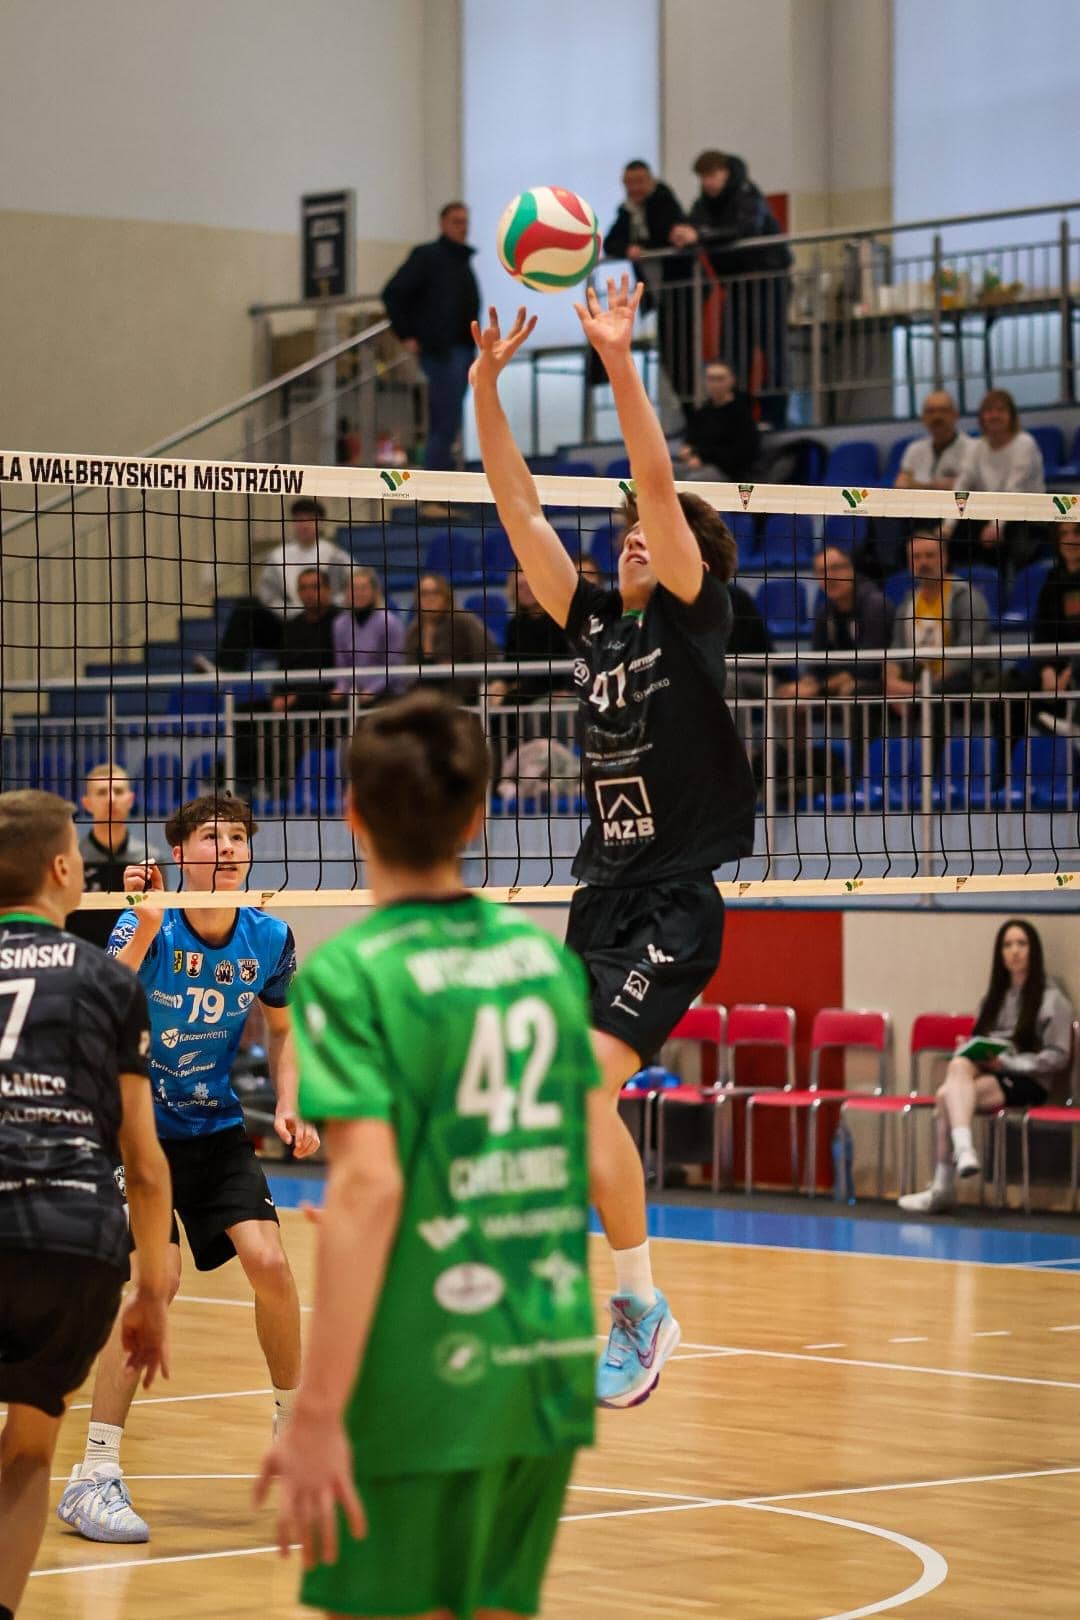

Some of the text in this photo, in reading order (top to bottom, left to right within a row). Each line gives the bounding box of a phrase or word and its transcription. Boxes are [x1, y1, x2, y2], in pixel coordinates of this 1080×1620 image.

[29, 457, 187, 489] WAŁBRZYSKICH
[193, 465, 304, 494] MISTRZÓW
[603, 817, 655, 841] MZB
[186, 986, 225, 1024] 79
[455, 995, 563, 1137] 42
